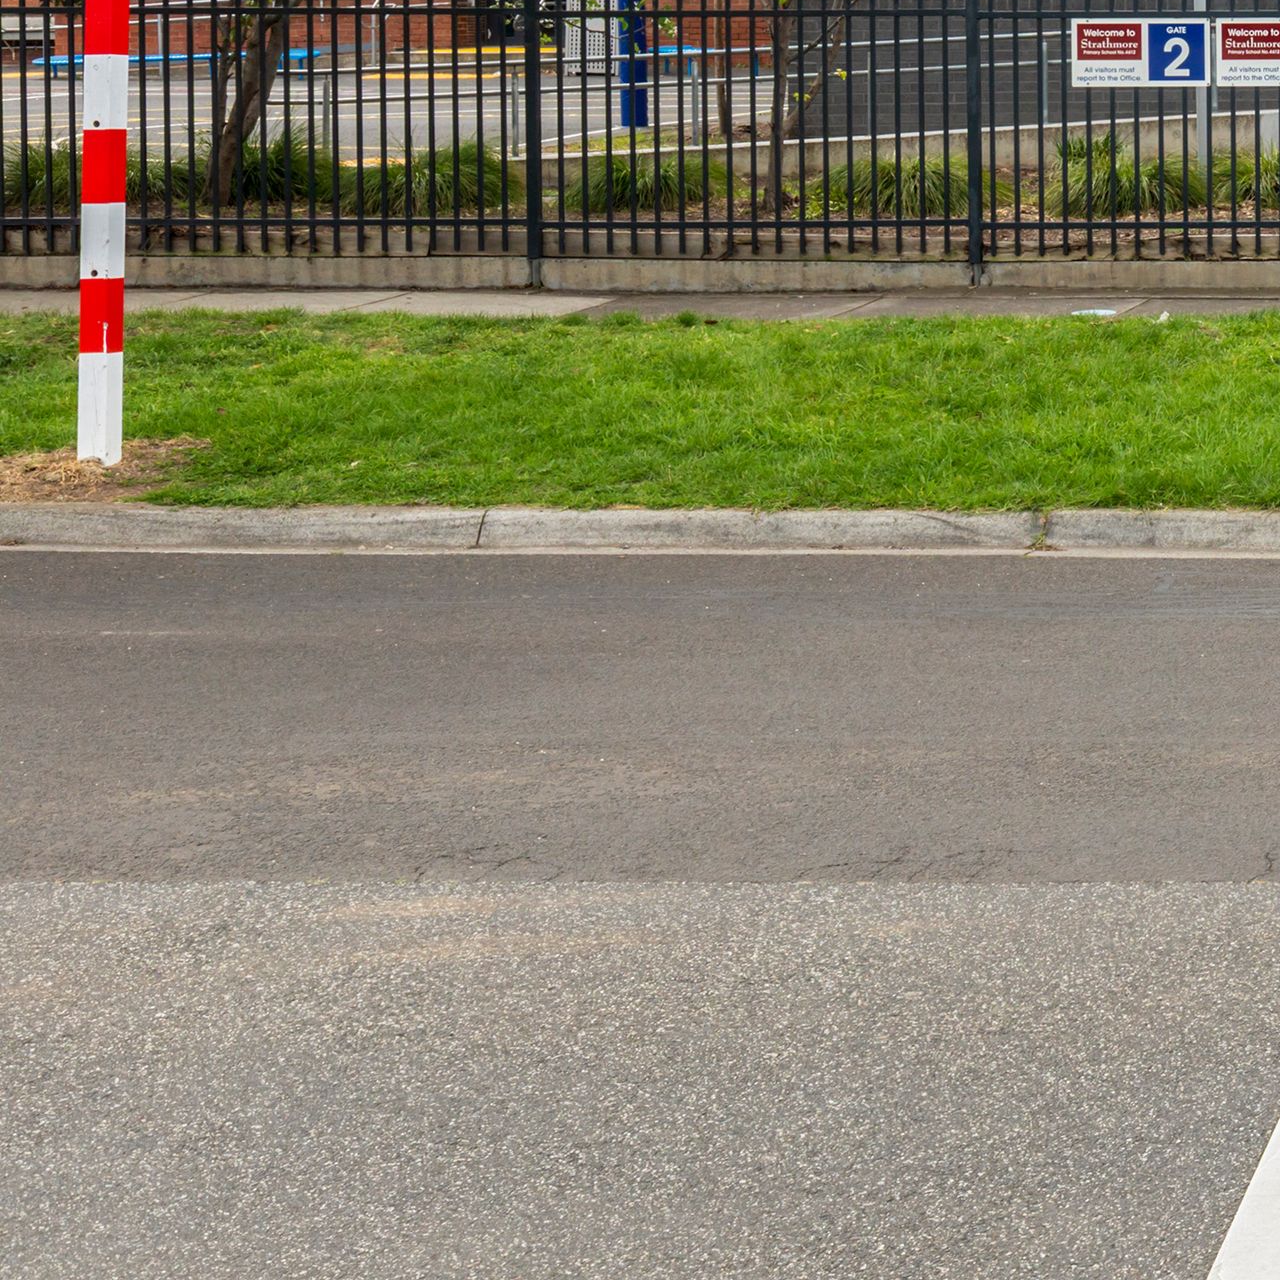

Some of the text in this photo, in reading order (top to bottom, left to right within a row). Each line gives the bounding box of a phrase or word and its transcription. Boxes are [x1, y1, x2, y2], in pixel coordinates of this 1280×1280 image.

[1083, 29, 1136, 37] Welcome to
[1166, 26, 1187, 34] GATE
[1227, 28, 1280, 37] Welcome to
[1081, 37, 1138, 48] Strathmore
[1163, 37, 1190, 77] 2
